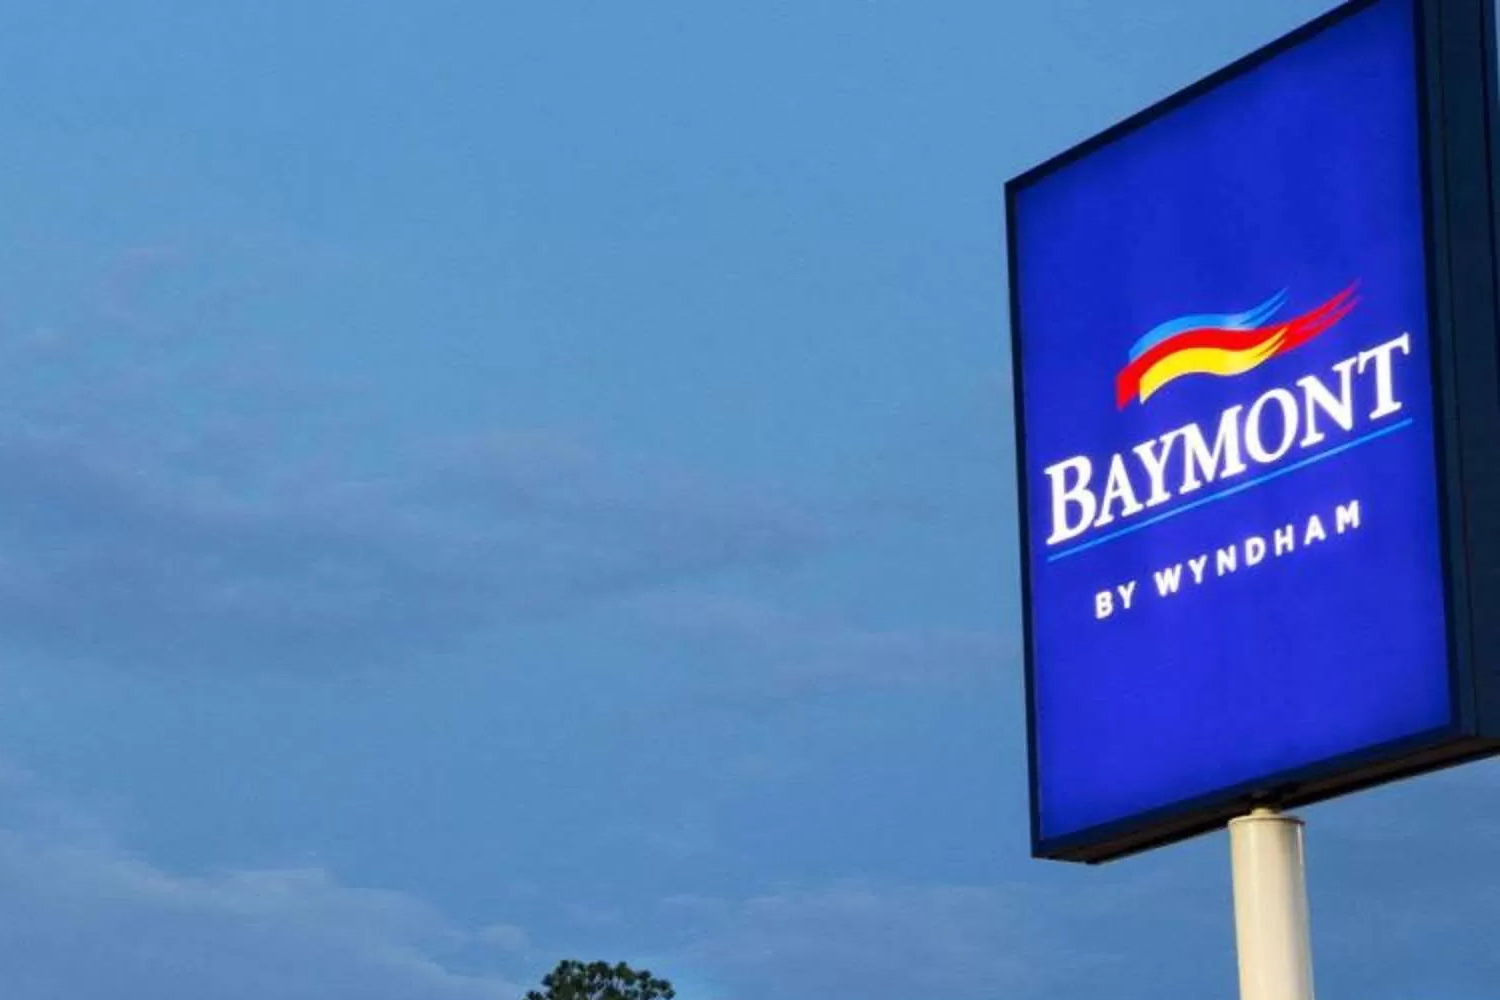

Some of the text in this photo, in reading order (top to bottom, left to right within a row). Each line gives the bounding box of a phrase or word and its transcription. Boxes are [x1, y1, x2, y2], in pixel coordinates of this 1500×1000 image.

[1044, 332, 1409, 546] BAYMONT
[1094, 500, 1361, 619] BY WYNDHAM
